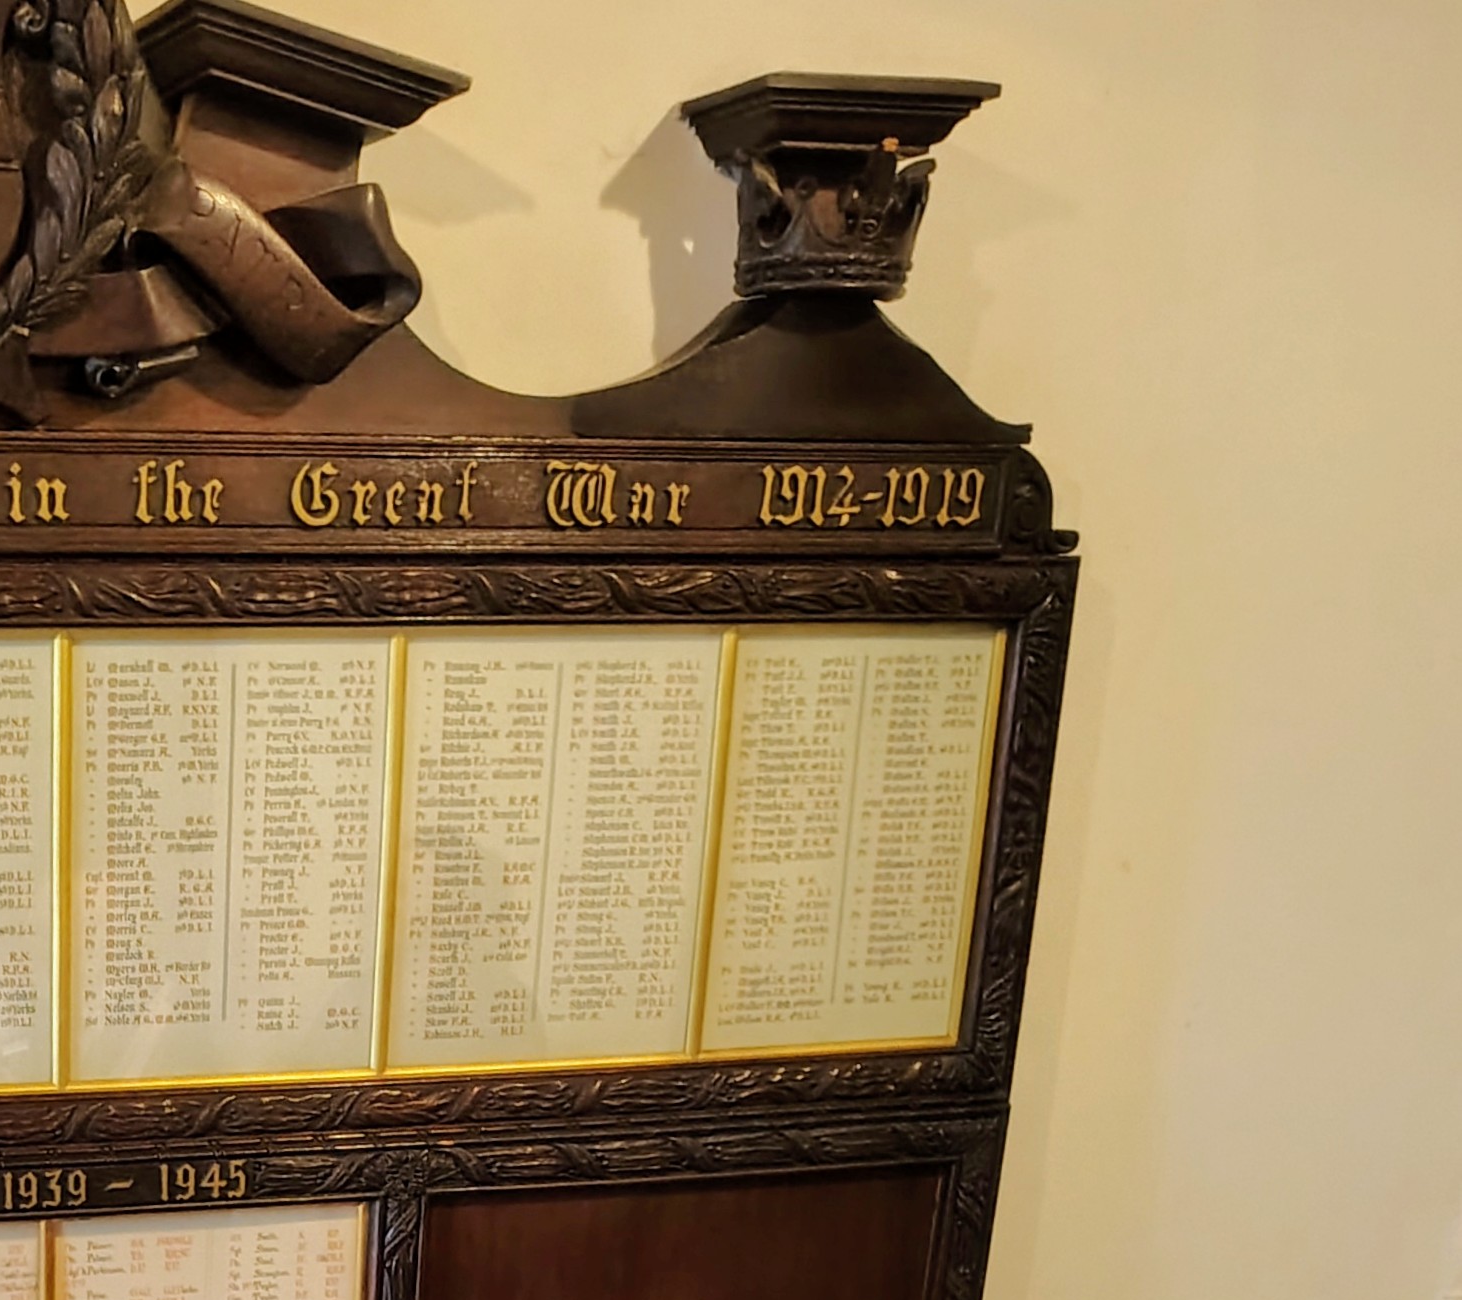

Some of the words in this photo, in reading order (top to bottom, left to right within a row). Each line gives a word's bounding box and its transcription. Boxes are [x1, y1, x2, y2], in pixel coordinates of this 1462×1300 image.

[8, 462, 70, 524] in
[133, 459, 225, 524] the
[291, 460, 478, 527] Great
[546, 460, 690, 527] War
[759, 463, 985, 528] 1914-1919
[3, 1169, 87, 1210] 1939
[158, 1158, 247, 1199] 1945
